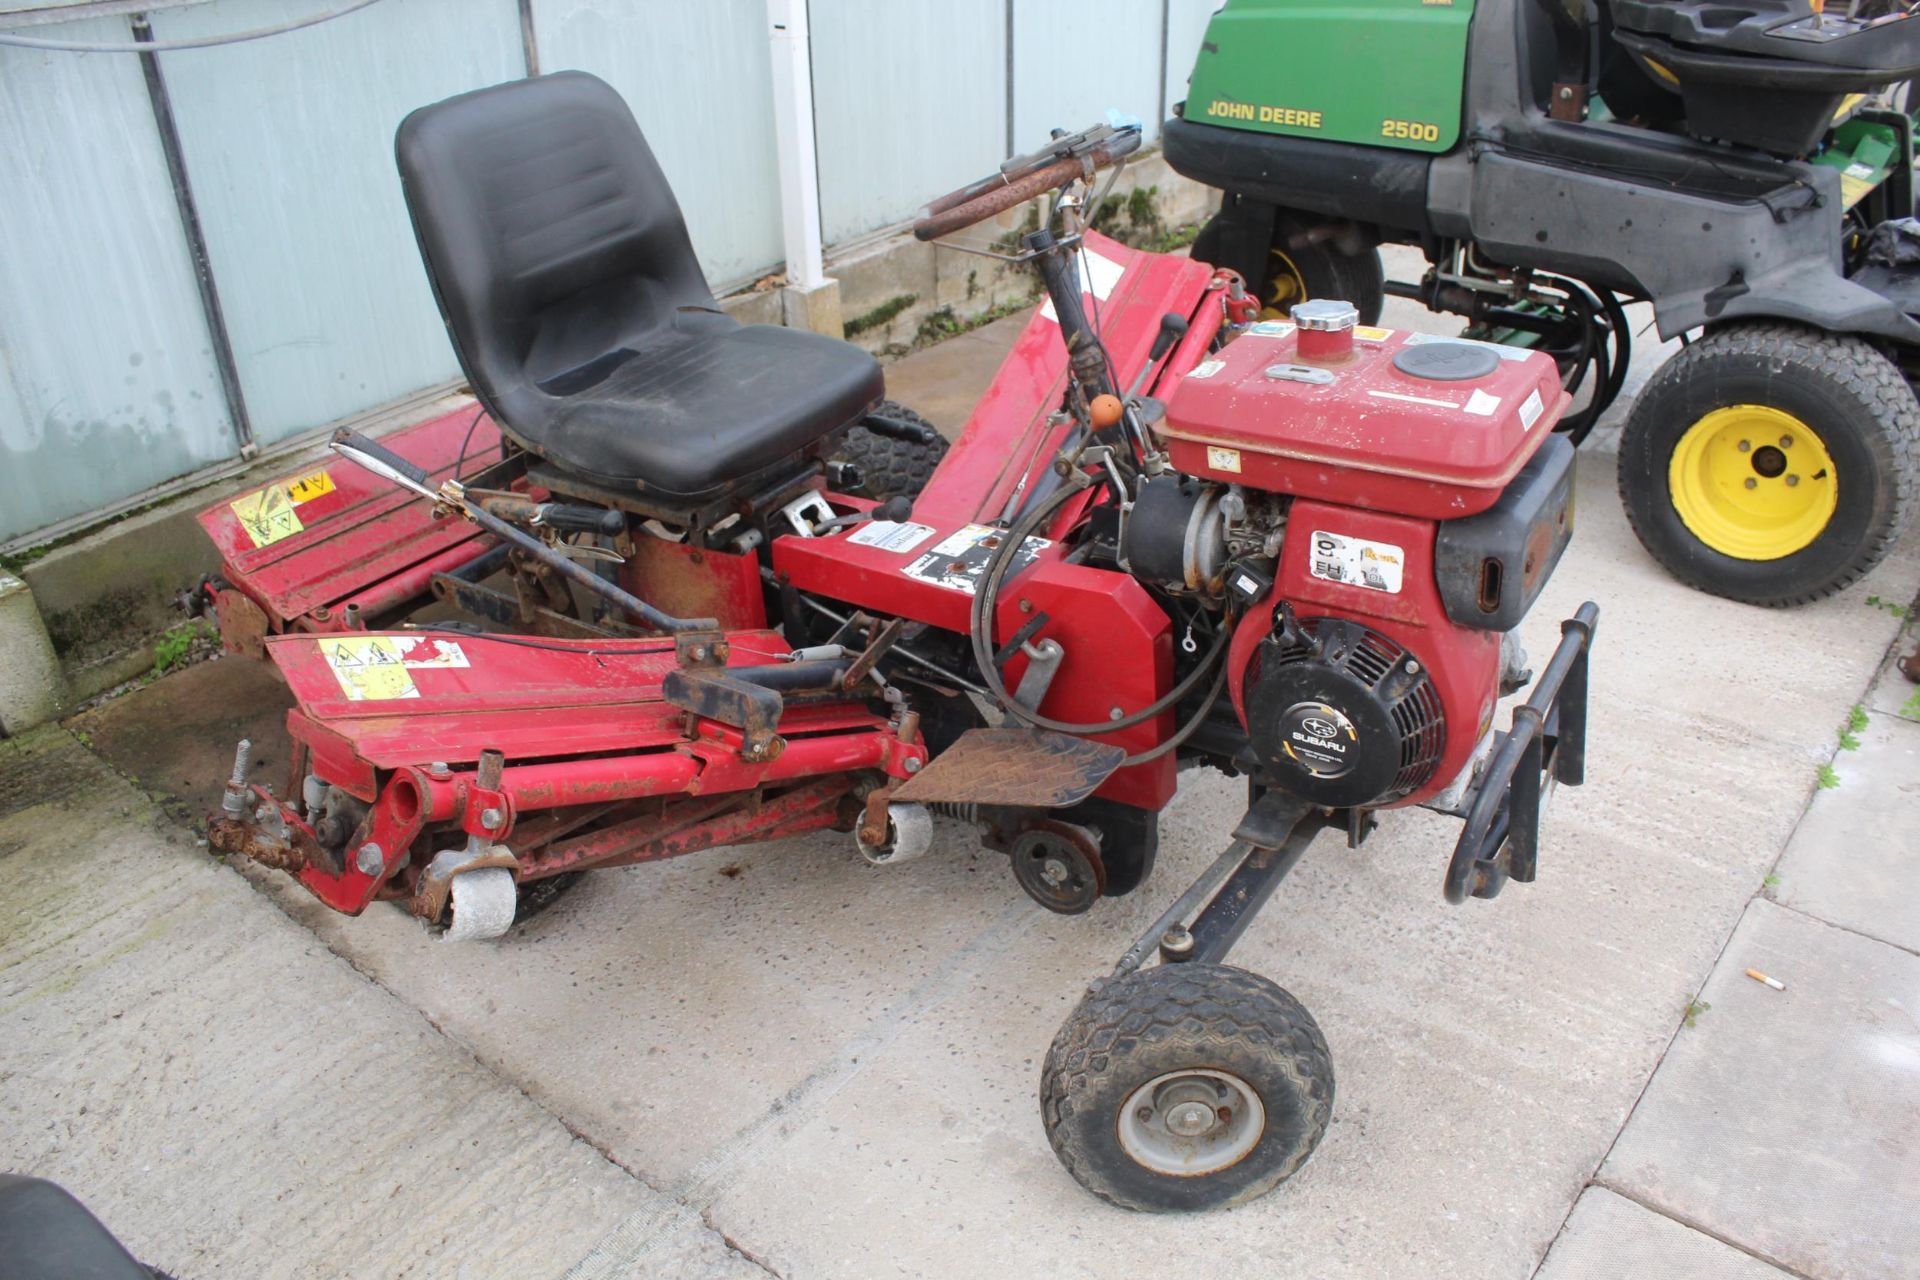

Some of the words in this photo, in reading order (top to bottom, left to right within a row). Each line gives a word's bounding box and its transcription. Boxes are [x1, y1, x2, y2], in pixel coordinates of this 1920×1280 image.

[1208, 100, 1254, 120] JOHN
[1259, 106, 1322, 128] DEERE
[1381, 119, 1439, 142] 2500
[1292, 732, 1346, 753] SUBARU
